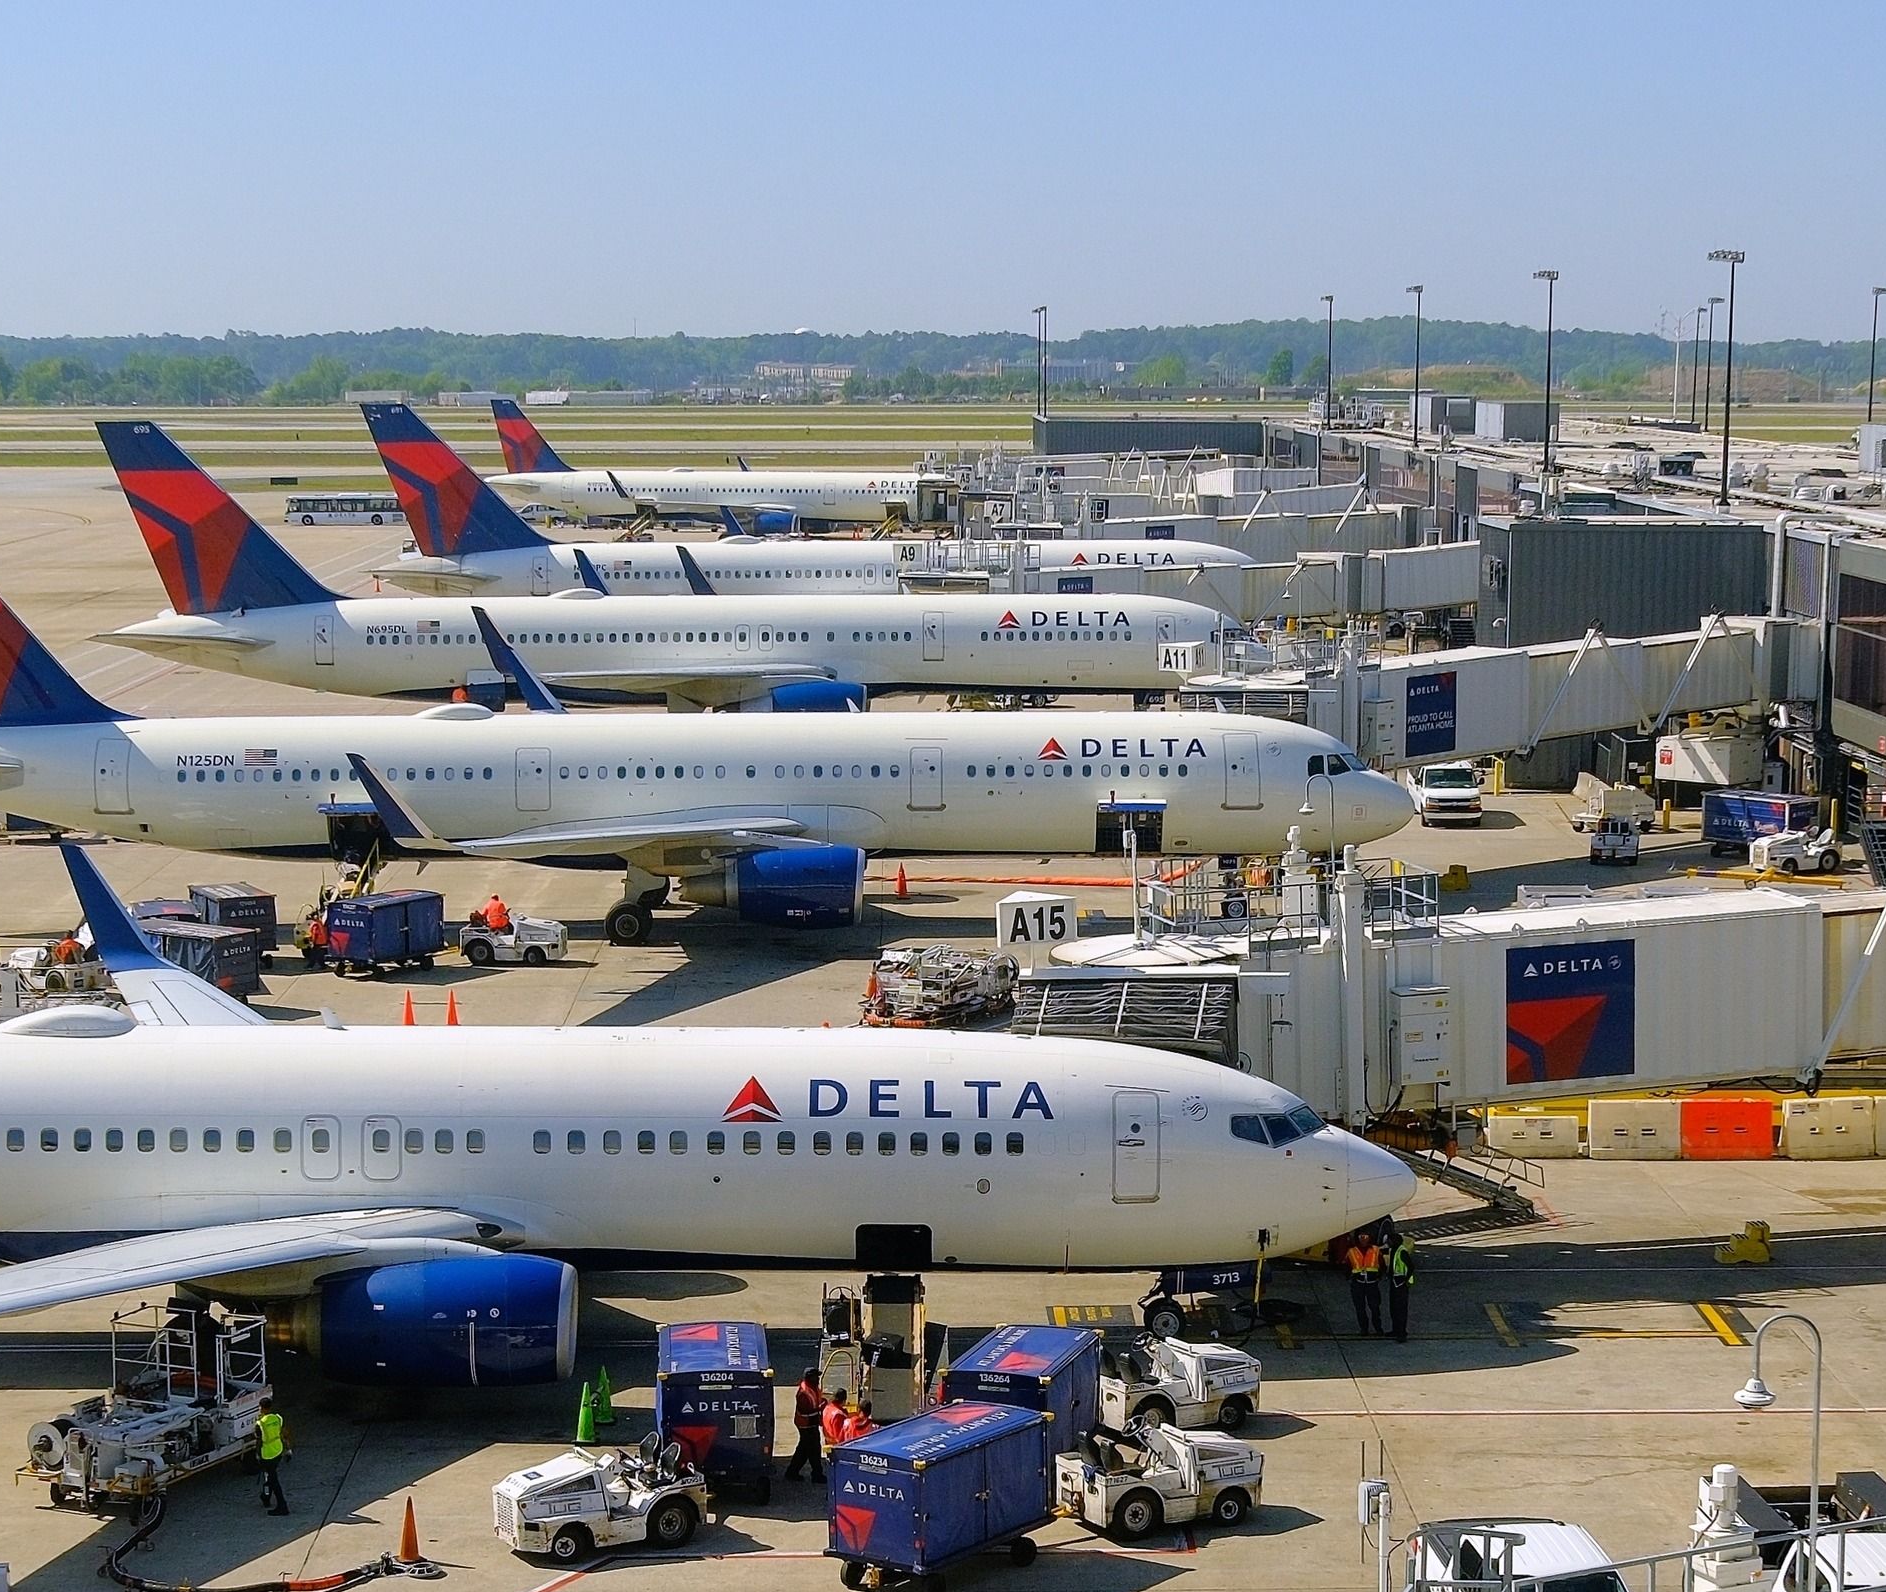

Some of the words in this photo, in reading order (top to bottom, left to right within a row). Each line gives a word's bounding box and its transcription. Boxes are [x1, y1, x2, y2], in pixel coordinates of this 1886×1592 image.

[133, 424, 151, 434] 695
[881, 480, 916, 489] DELT
[991, 503, 1005, 516] A7
[900, 546, 915, 562] A9
[1097, 552, 1175, 566] DELTA
[1031, 611, 1130, 627] DELTA
[367, 624, 406, 634] N695DL
[1164, 648, 1186, 670] A11
[1416, 684, 1440, 695] DELTA
[1407, 713, 1428, 725] PROUD
[1430, 712, 1438, 722] TO
[1439, 710, 1454, 720] CALL
[1407, 722, 1435, 733] ATLANTA
[1436, 719, 1455, 729] HOME
[1081, 738, 1207, 758] DELTA
[176, 754, 235, 767] N125DN
[1721, 818, 1749, 828] DELTA
[238, 909, 266, 917] DELTA
[340, 920, 366, 929] DELTA
[1009, 905, 1065, 943] A15
[230, 946, 251, 955] DELTA
[1543, 958, 1603, 974] DELTA
[809, 1079, 1053, 1121] DELTA
[1213, 1271, 1240, 1285] 3713
[700, 1372, 734, 1382] 136204
[979, 1373, 1010, 1384] 136264
[698, 1399, 752, 1413] DELTA
[859, 1455, 888, 1467] 136234
[1212, 1461, 1246, 1478] TUG
[858, 1482, 905, 1501] DELTA
